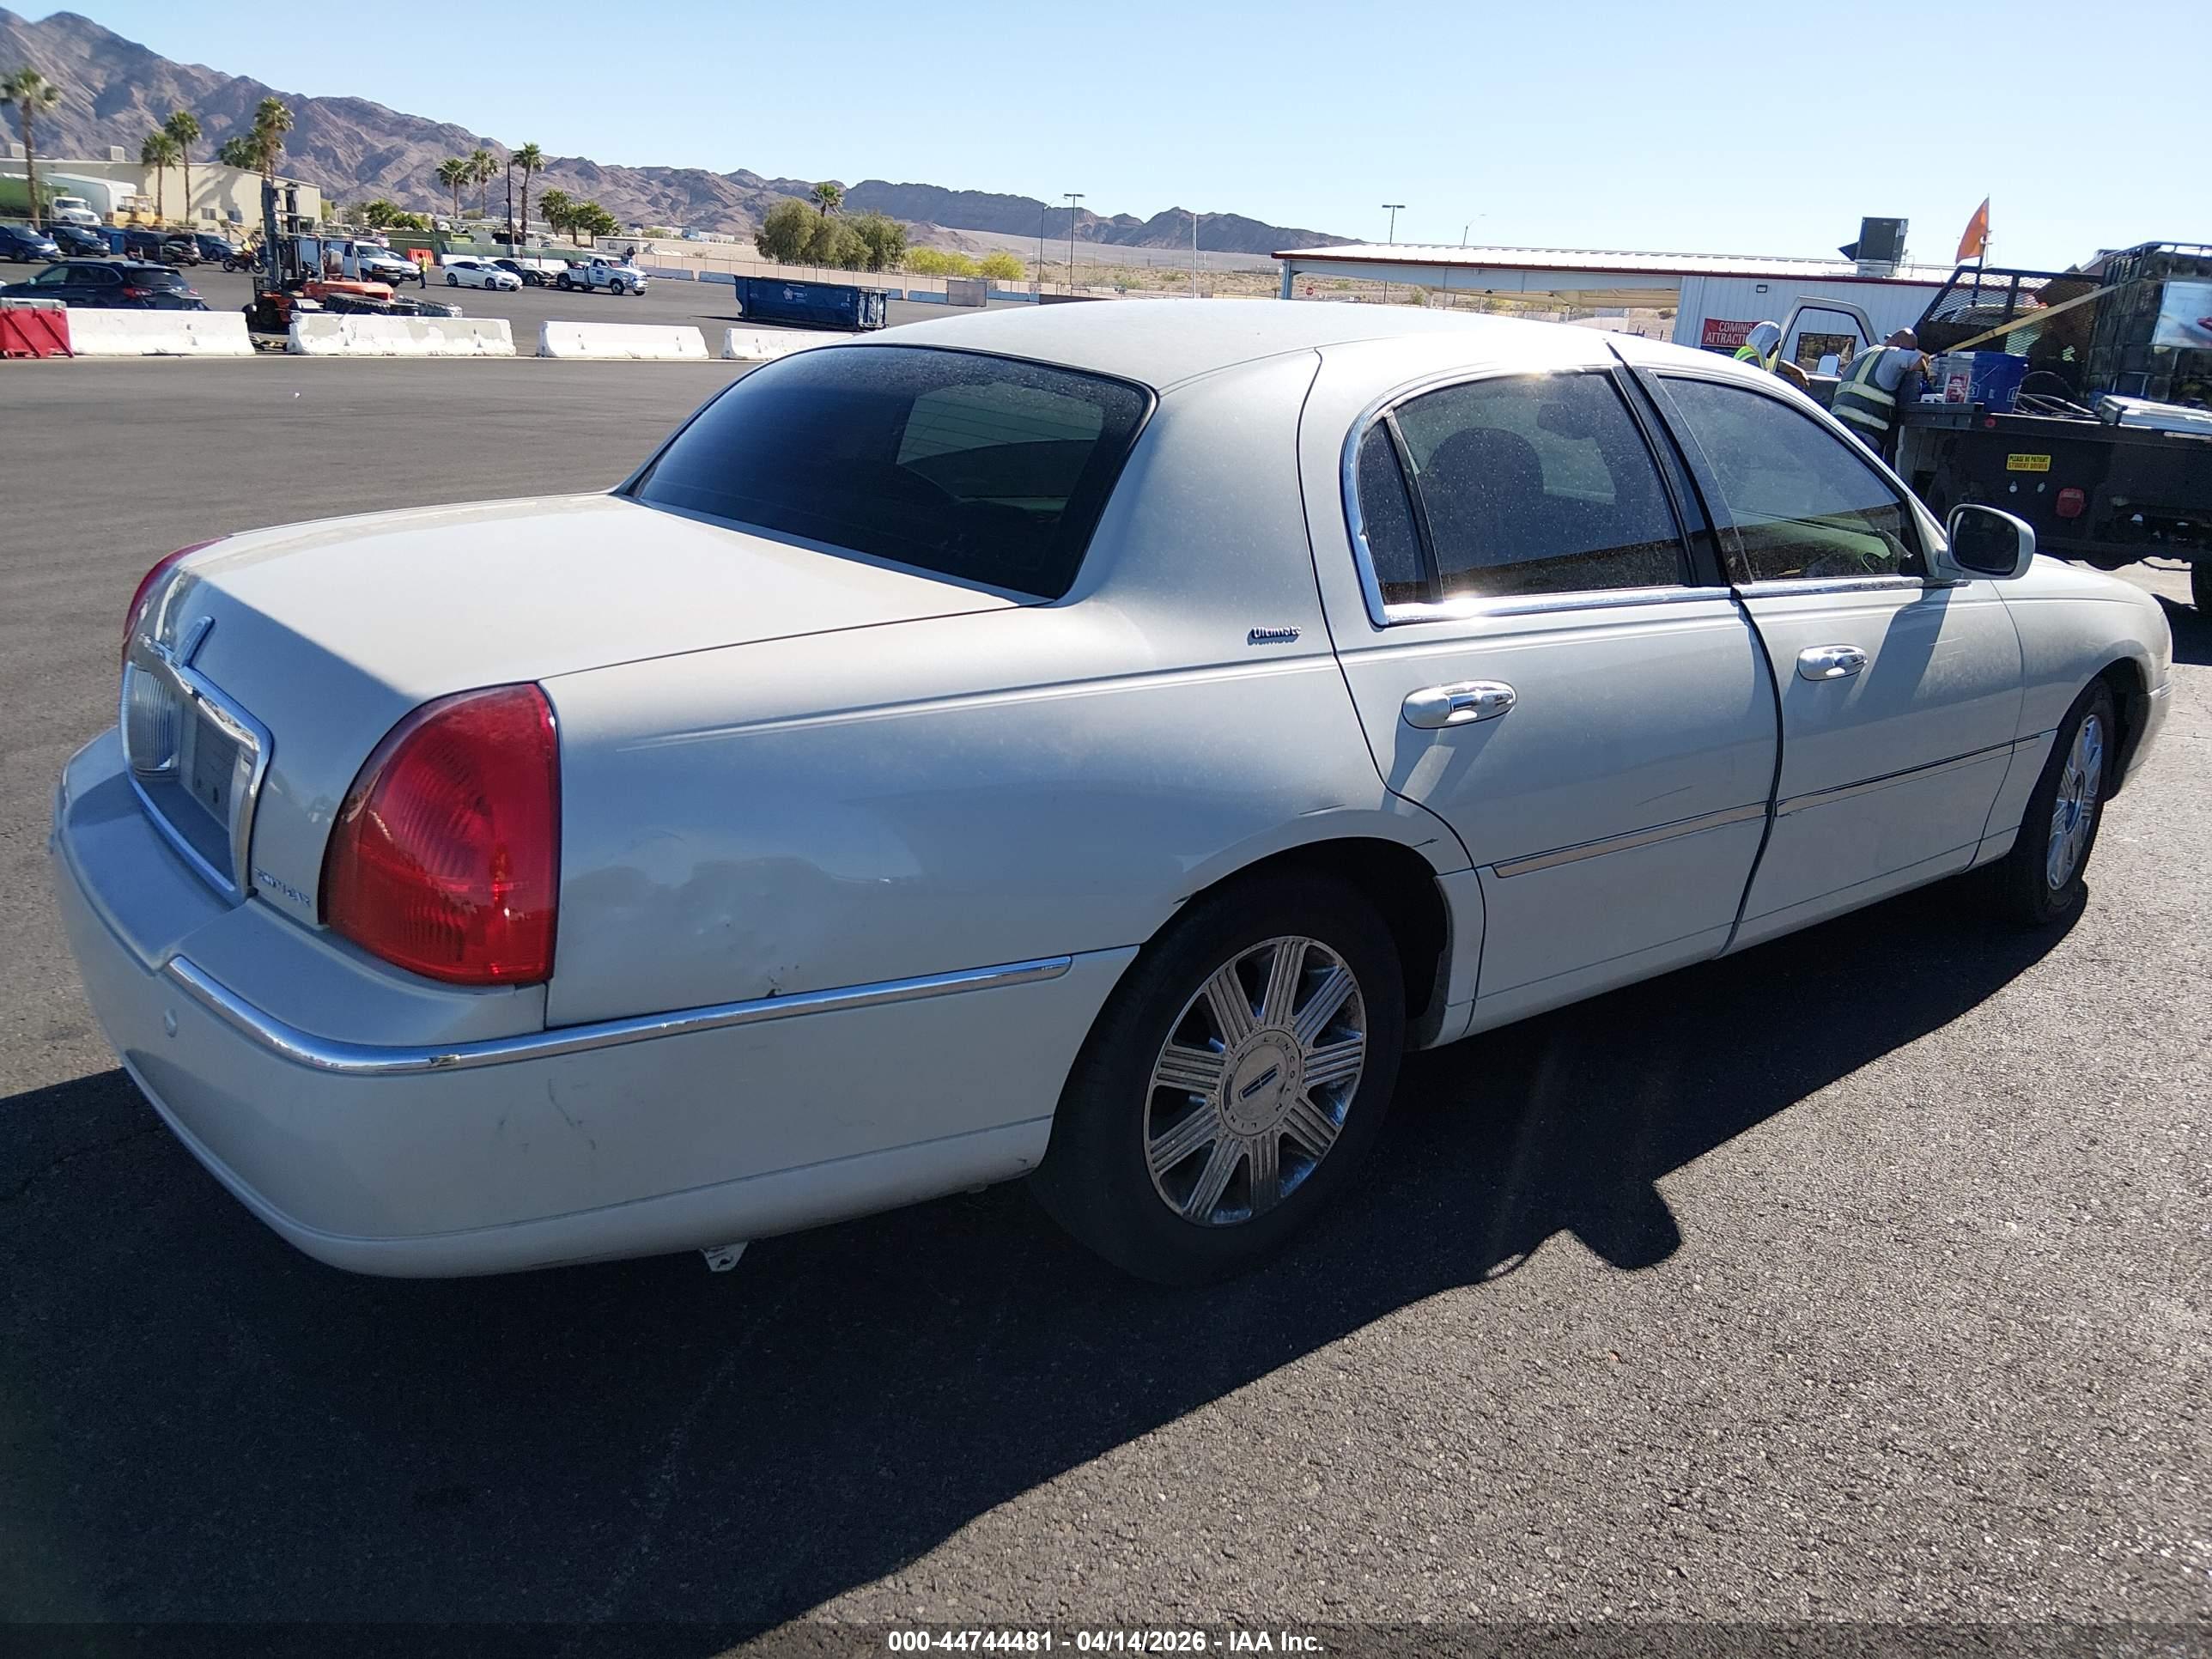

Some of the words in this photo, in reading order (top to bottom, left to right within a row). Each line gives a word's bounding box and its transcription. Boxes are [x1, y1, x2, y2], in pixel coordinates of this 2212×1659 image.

[1718, 321, 1753, 334] COMING
[1705, 331, 1747, 345] ATTRACTI
[1251, 625, 1303, 640] Ultimate
